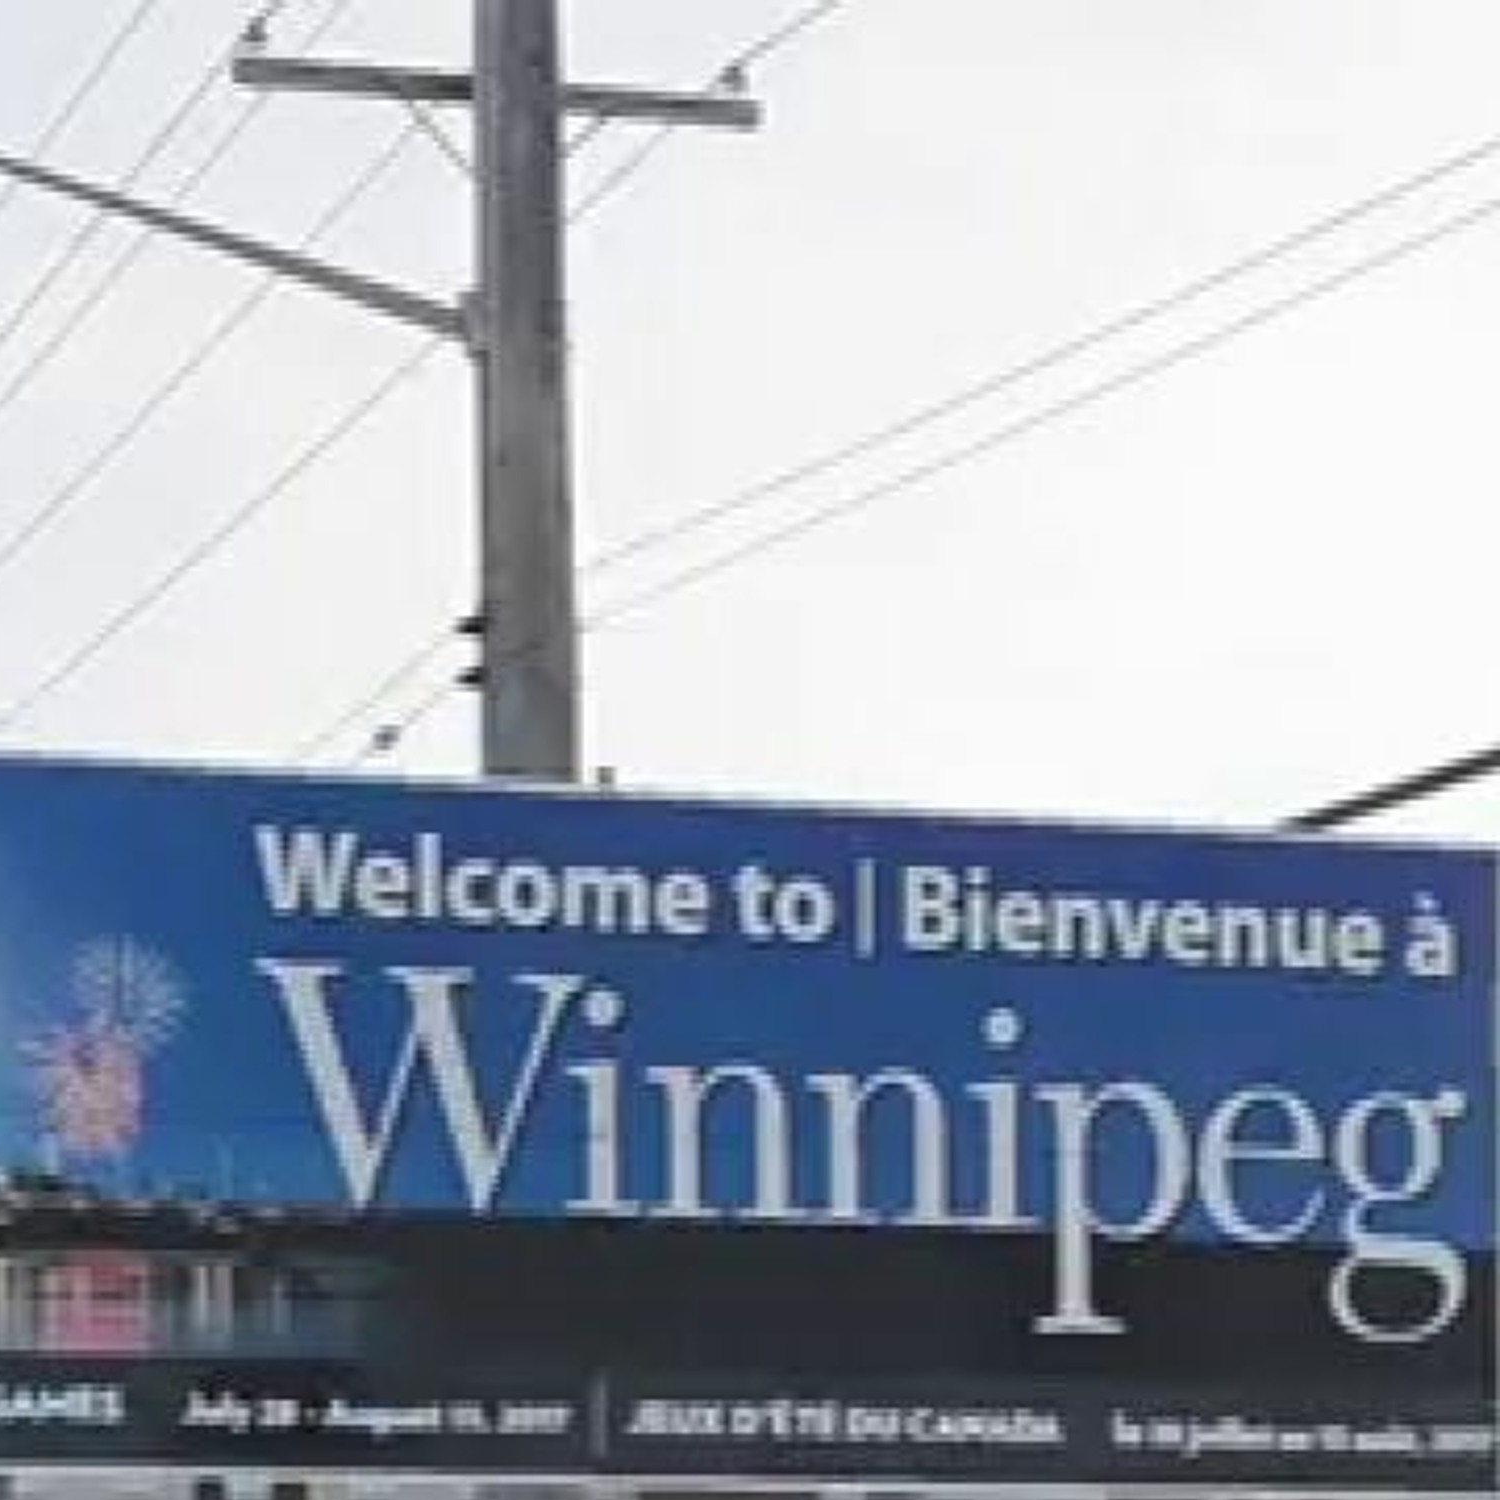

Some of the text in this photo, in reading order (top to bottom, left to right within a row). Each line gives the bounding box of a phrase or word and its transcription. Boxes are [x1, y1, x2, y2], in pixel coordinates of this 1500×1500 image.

[254, 823, 837, 943] Welcome to
[902, 865, 1457, 976] Bienvenue à
[255, 956, 1467, 1342] Winnipeg
